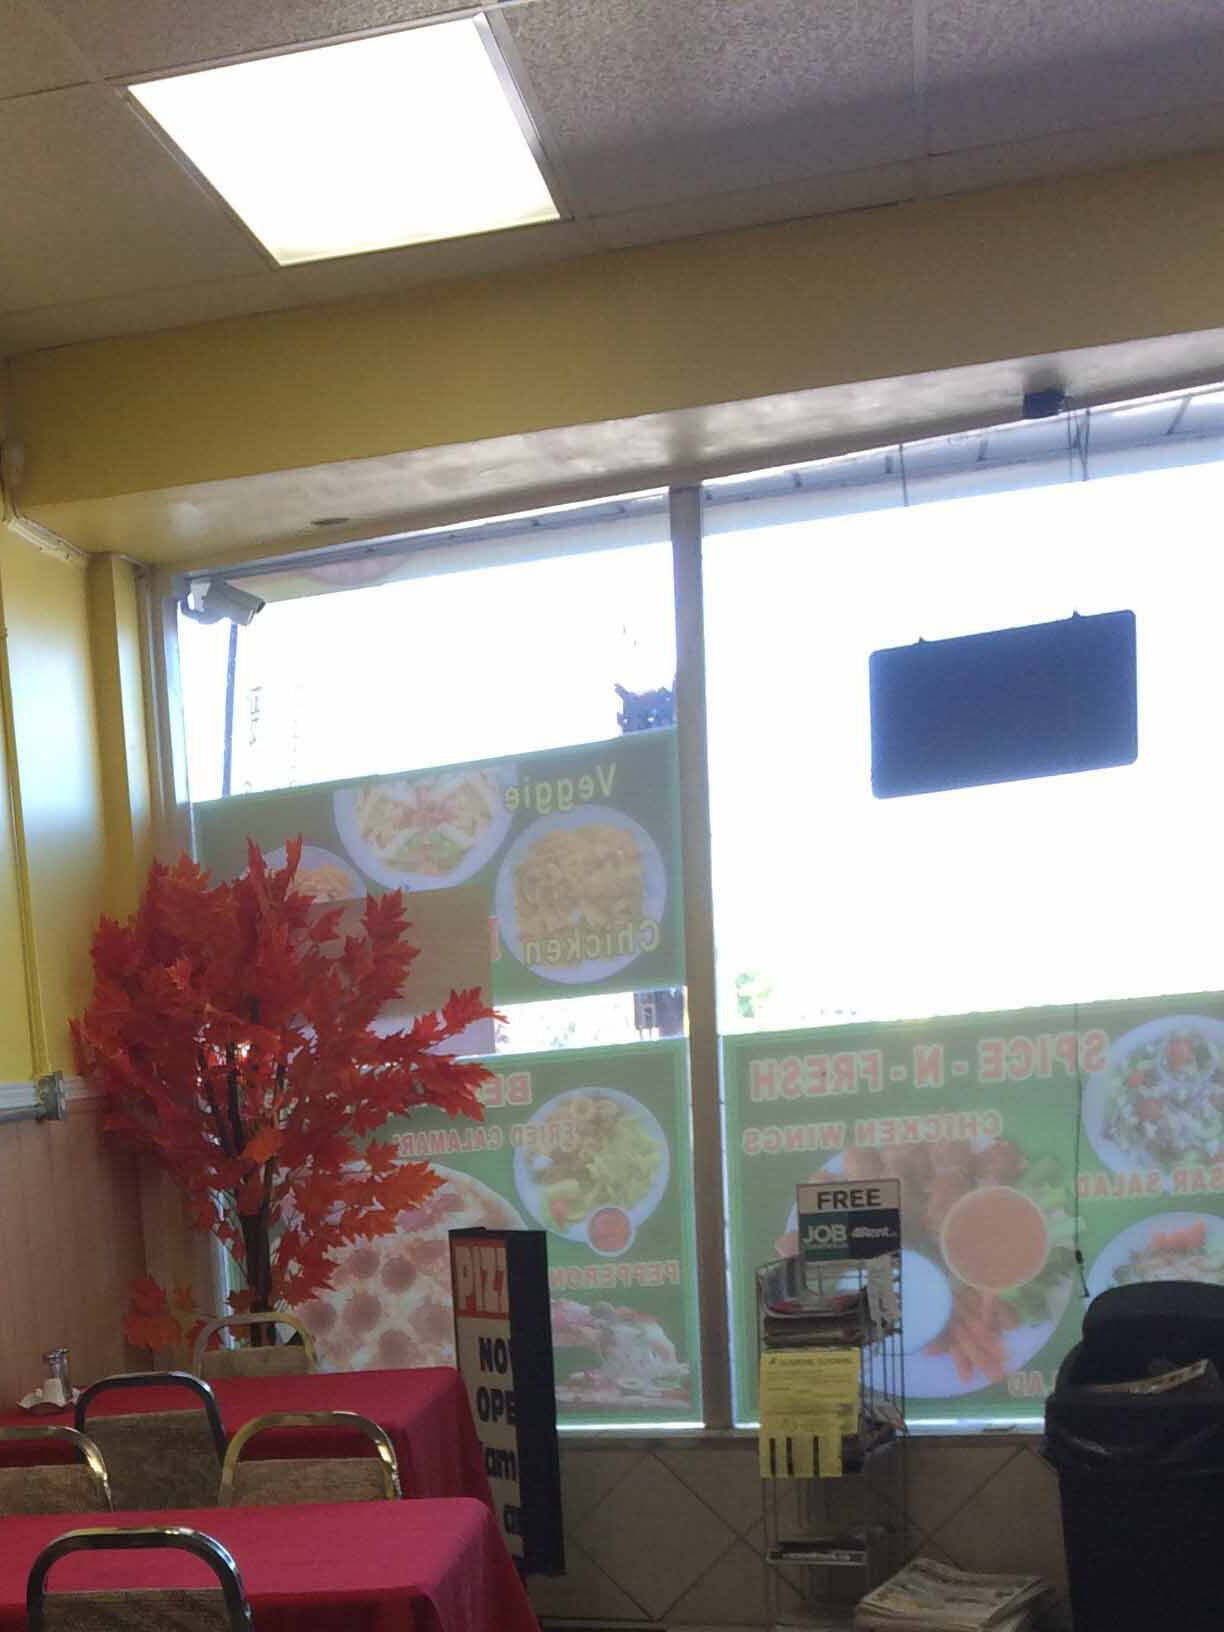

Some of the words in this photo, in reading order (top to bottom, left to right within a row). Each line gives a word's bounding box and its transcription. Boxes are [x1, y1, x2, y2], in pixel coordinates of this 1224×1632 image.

[816, 1188, 882, 1211] FREE
[802, 1223, 847, 1244] JOB
[455, 1247, 509, 1313] PIZZ
[478, 1336, 511, 1375] NO
[477, 1386, 521, 1424] OPE
[482, 1446, 517, 1480] am
